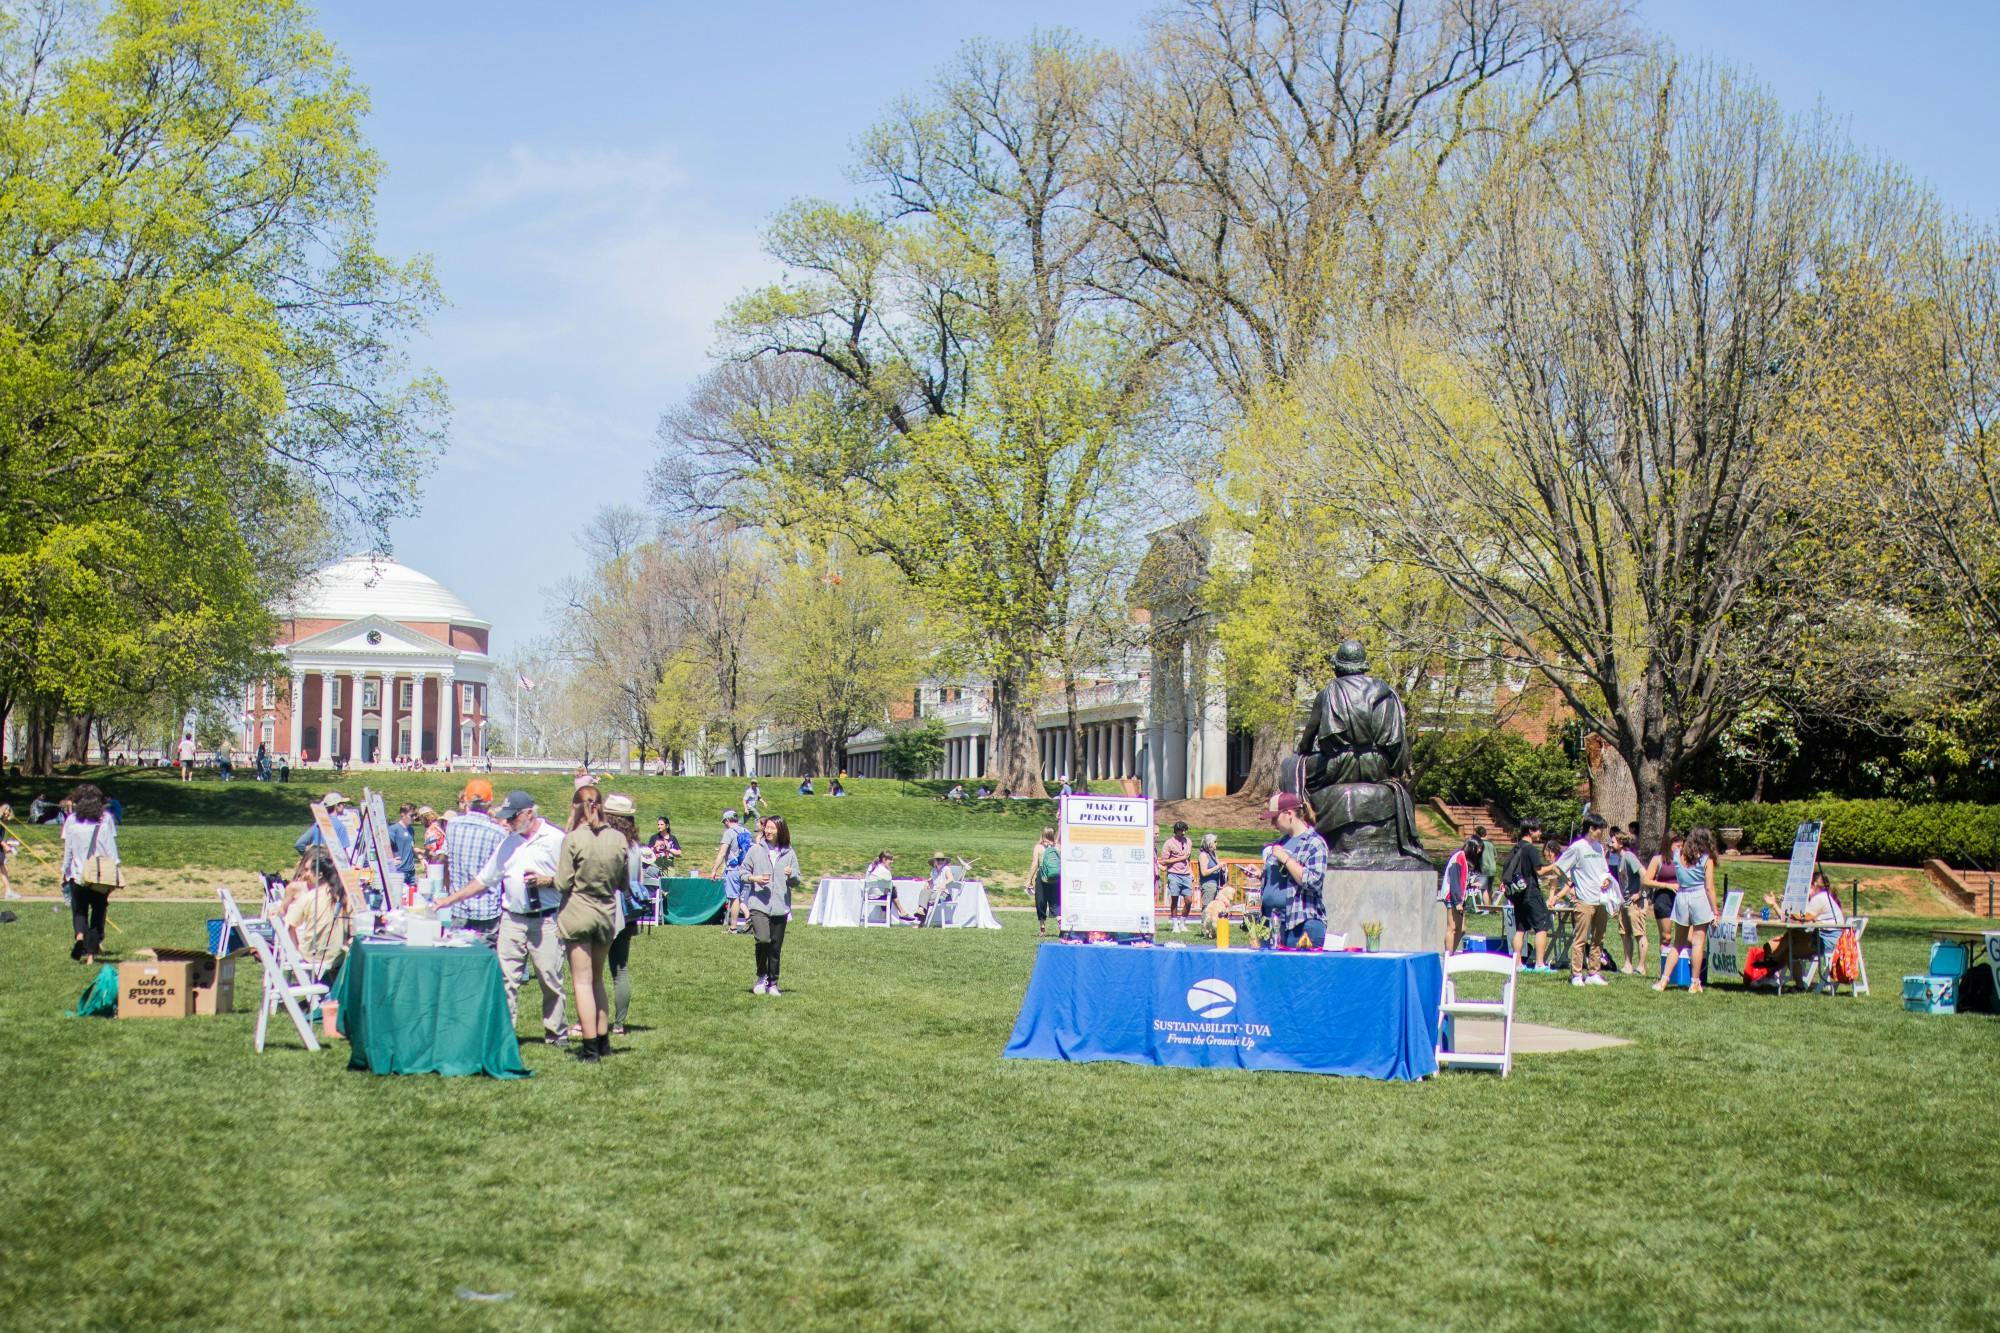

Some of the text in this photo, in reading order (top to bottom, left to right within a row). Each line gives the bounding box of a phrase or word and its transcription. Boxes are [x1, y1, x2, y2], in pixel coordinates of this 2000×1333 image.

[1086, 802, 1115, 811] MAKE
[1079, 813, 1136, 823] PERSONAL
[138, 975, 167, 987] who
[128, 987, 175, 999] gives a
[137, 996, 167, 1008] crap
[1153, 1019, 1272, 1037] SUSTAINABILITY UVA
[1166, 1033, 1191, 1045] From
[1192, 1034, 1205, 1045] the
[1241, 1036, 1255, 1050] Up
